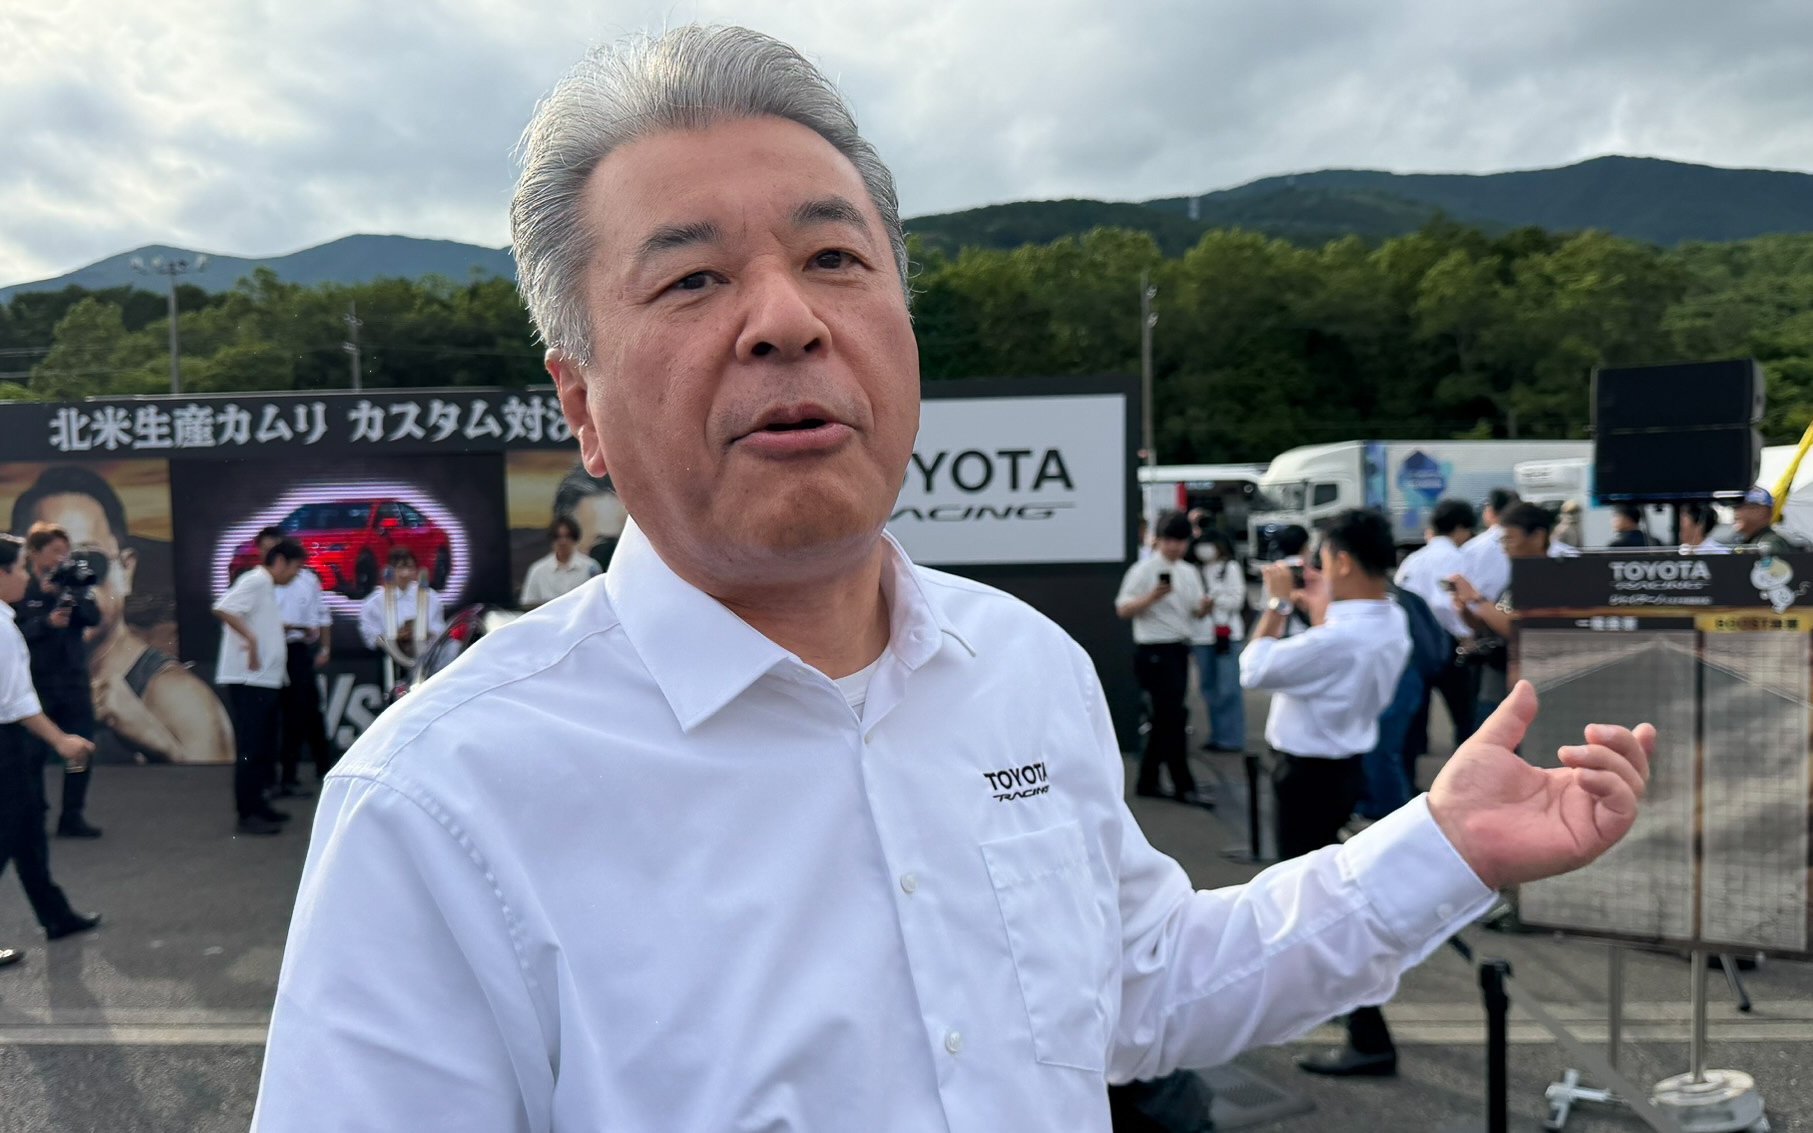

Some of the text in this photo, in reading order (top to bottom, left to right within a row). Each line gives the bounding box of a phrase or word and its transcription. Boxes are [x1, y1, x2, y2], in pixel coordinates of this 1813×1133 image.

[49, 402, 328, 451] 北米生産カムリ
[902, 448, 1075, 494] YOTA
[889, 501, 1075, 521] ACING
[1608, 560, 1711, 581] TOYOTA
[993, 784, 1050, 803] RACING
